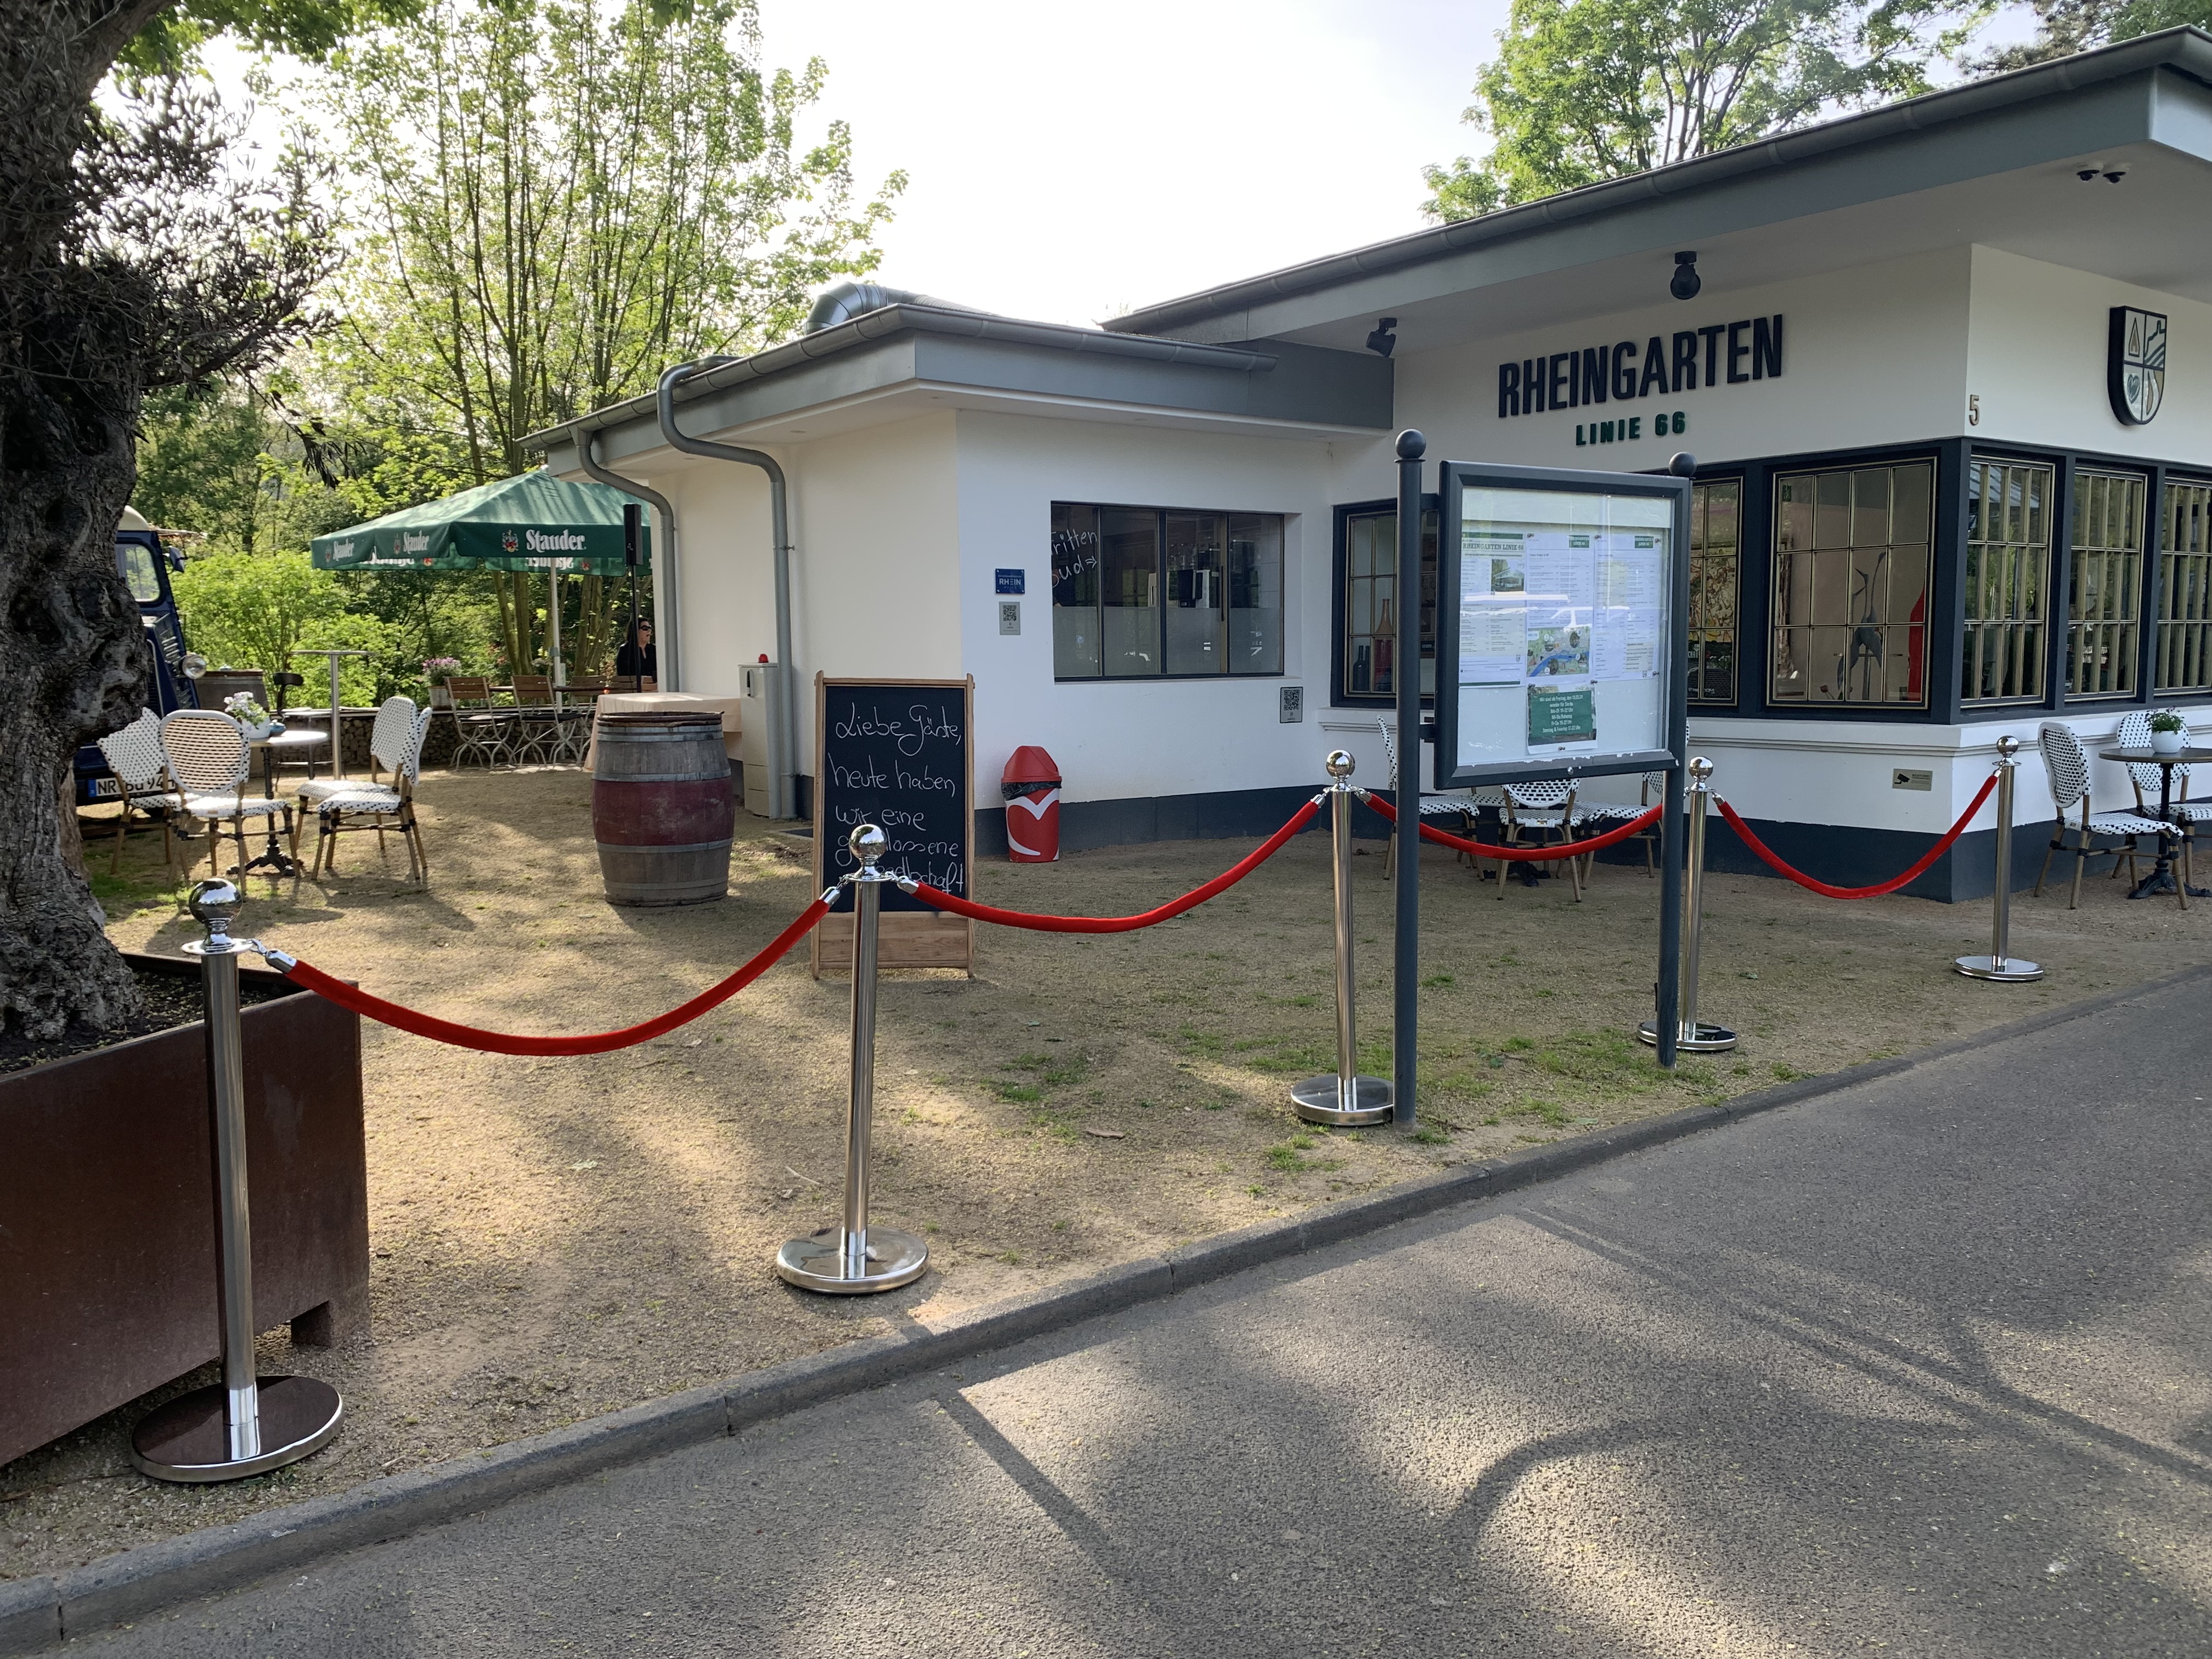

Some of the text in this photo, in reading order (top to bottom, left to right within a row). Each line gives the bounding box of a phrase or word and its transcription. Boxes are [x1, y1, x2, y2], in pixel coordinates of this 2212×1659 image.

[1498, 314, 1783, 418] RHEINGARTEN
[1968, 394, 1980, 426] 5
[1576, 411, 1685, 446] LINIE 66
[332, 538, 354, 561] Stauder
[403, 530, 430, 555] Stauder
[526, 529, 585, 553] Stauder
[836, 702, 906, 739] Liebe
[97, 780, 117, 795] NR
[828, 752, 956, 798] heute haben
[881, 809, 926, 831] eine
